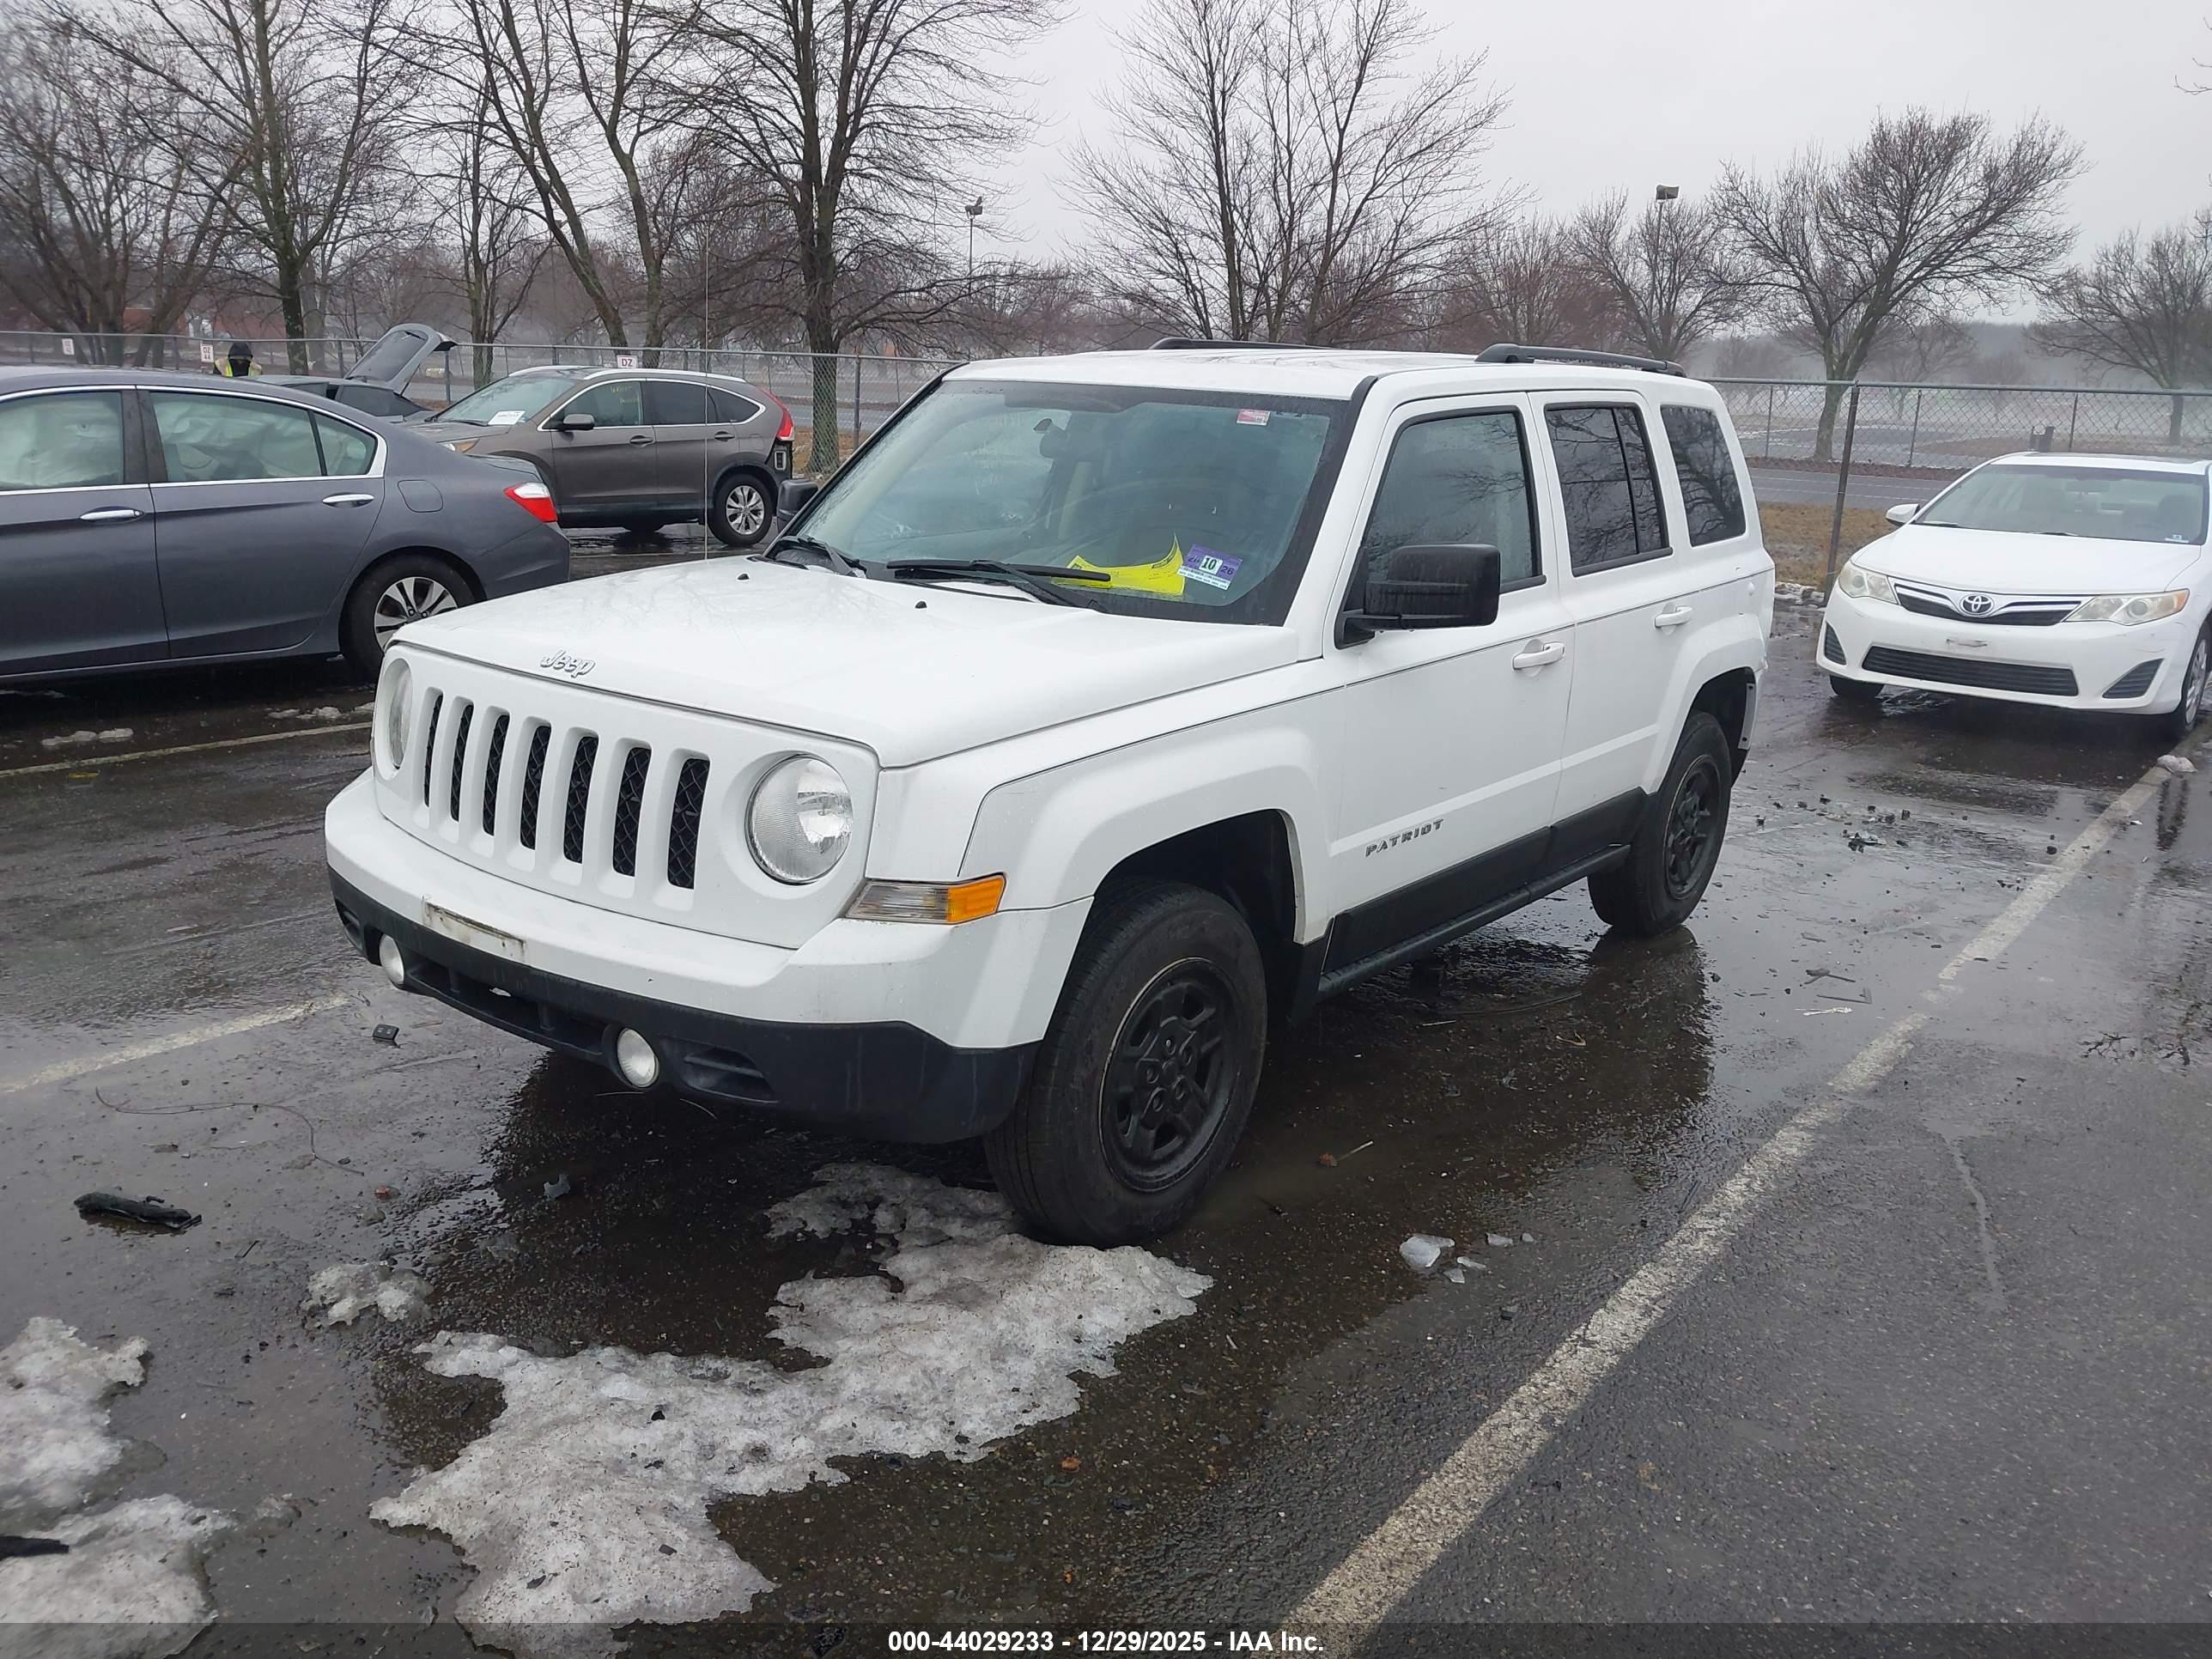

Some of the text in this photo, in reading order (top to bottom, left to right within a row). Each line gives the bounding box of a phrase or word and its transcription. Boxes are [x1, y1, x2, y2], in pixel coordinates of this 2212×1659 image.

[621, 358, 633, 367] DZ
[1201, 557, 1218, 570] 10
[1220, 565, 1235, 575] 26
[539, 649, 596, 678] Jeep
[1365, 818, 1444, 857] PATRIOT
